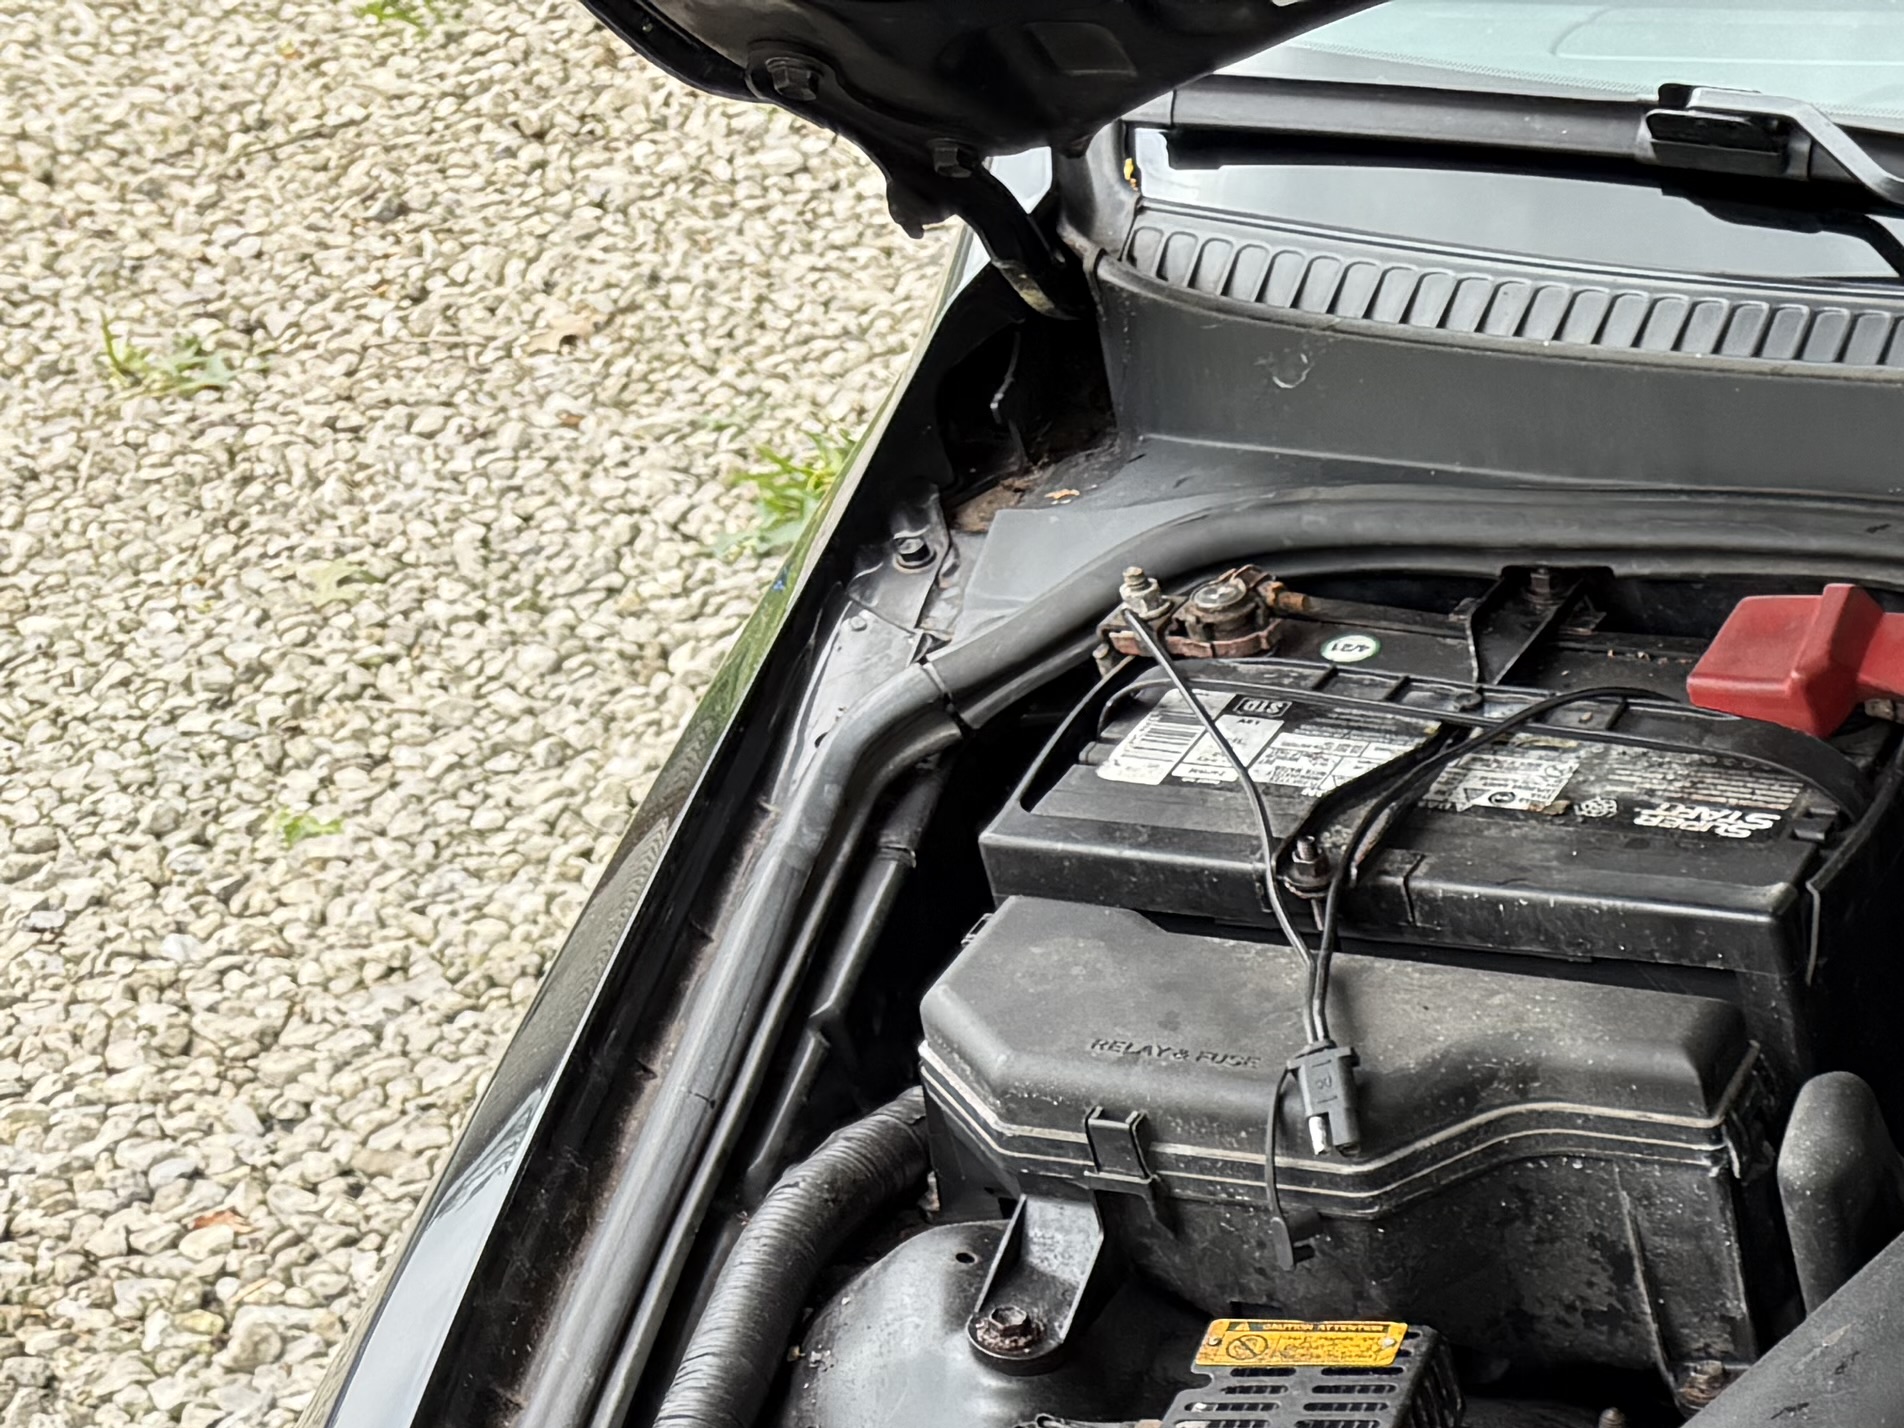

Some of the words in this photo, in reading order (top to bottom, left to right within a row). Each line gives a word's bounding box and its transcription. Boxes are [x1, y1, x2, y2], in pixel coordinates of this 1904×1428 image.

[1633, 815, 1752, 839] SUPER
[1636, 802, 1782, 830] START
[1091, 1038, 1171, 1059] RELAY
[1196, 1051, 1262, 1069] FUSE
